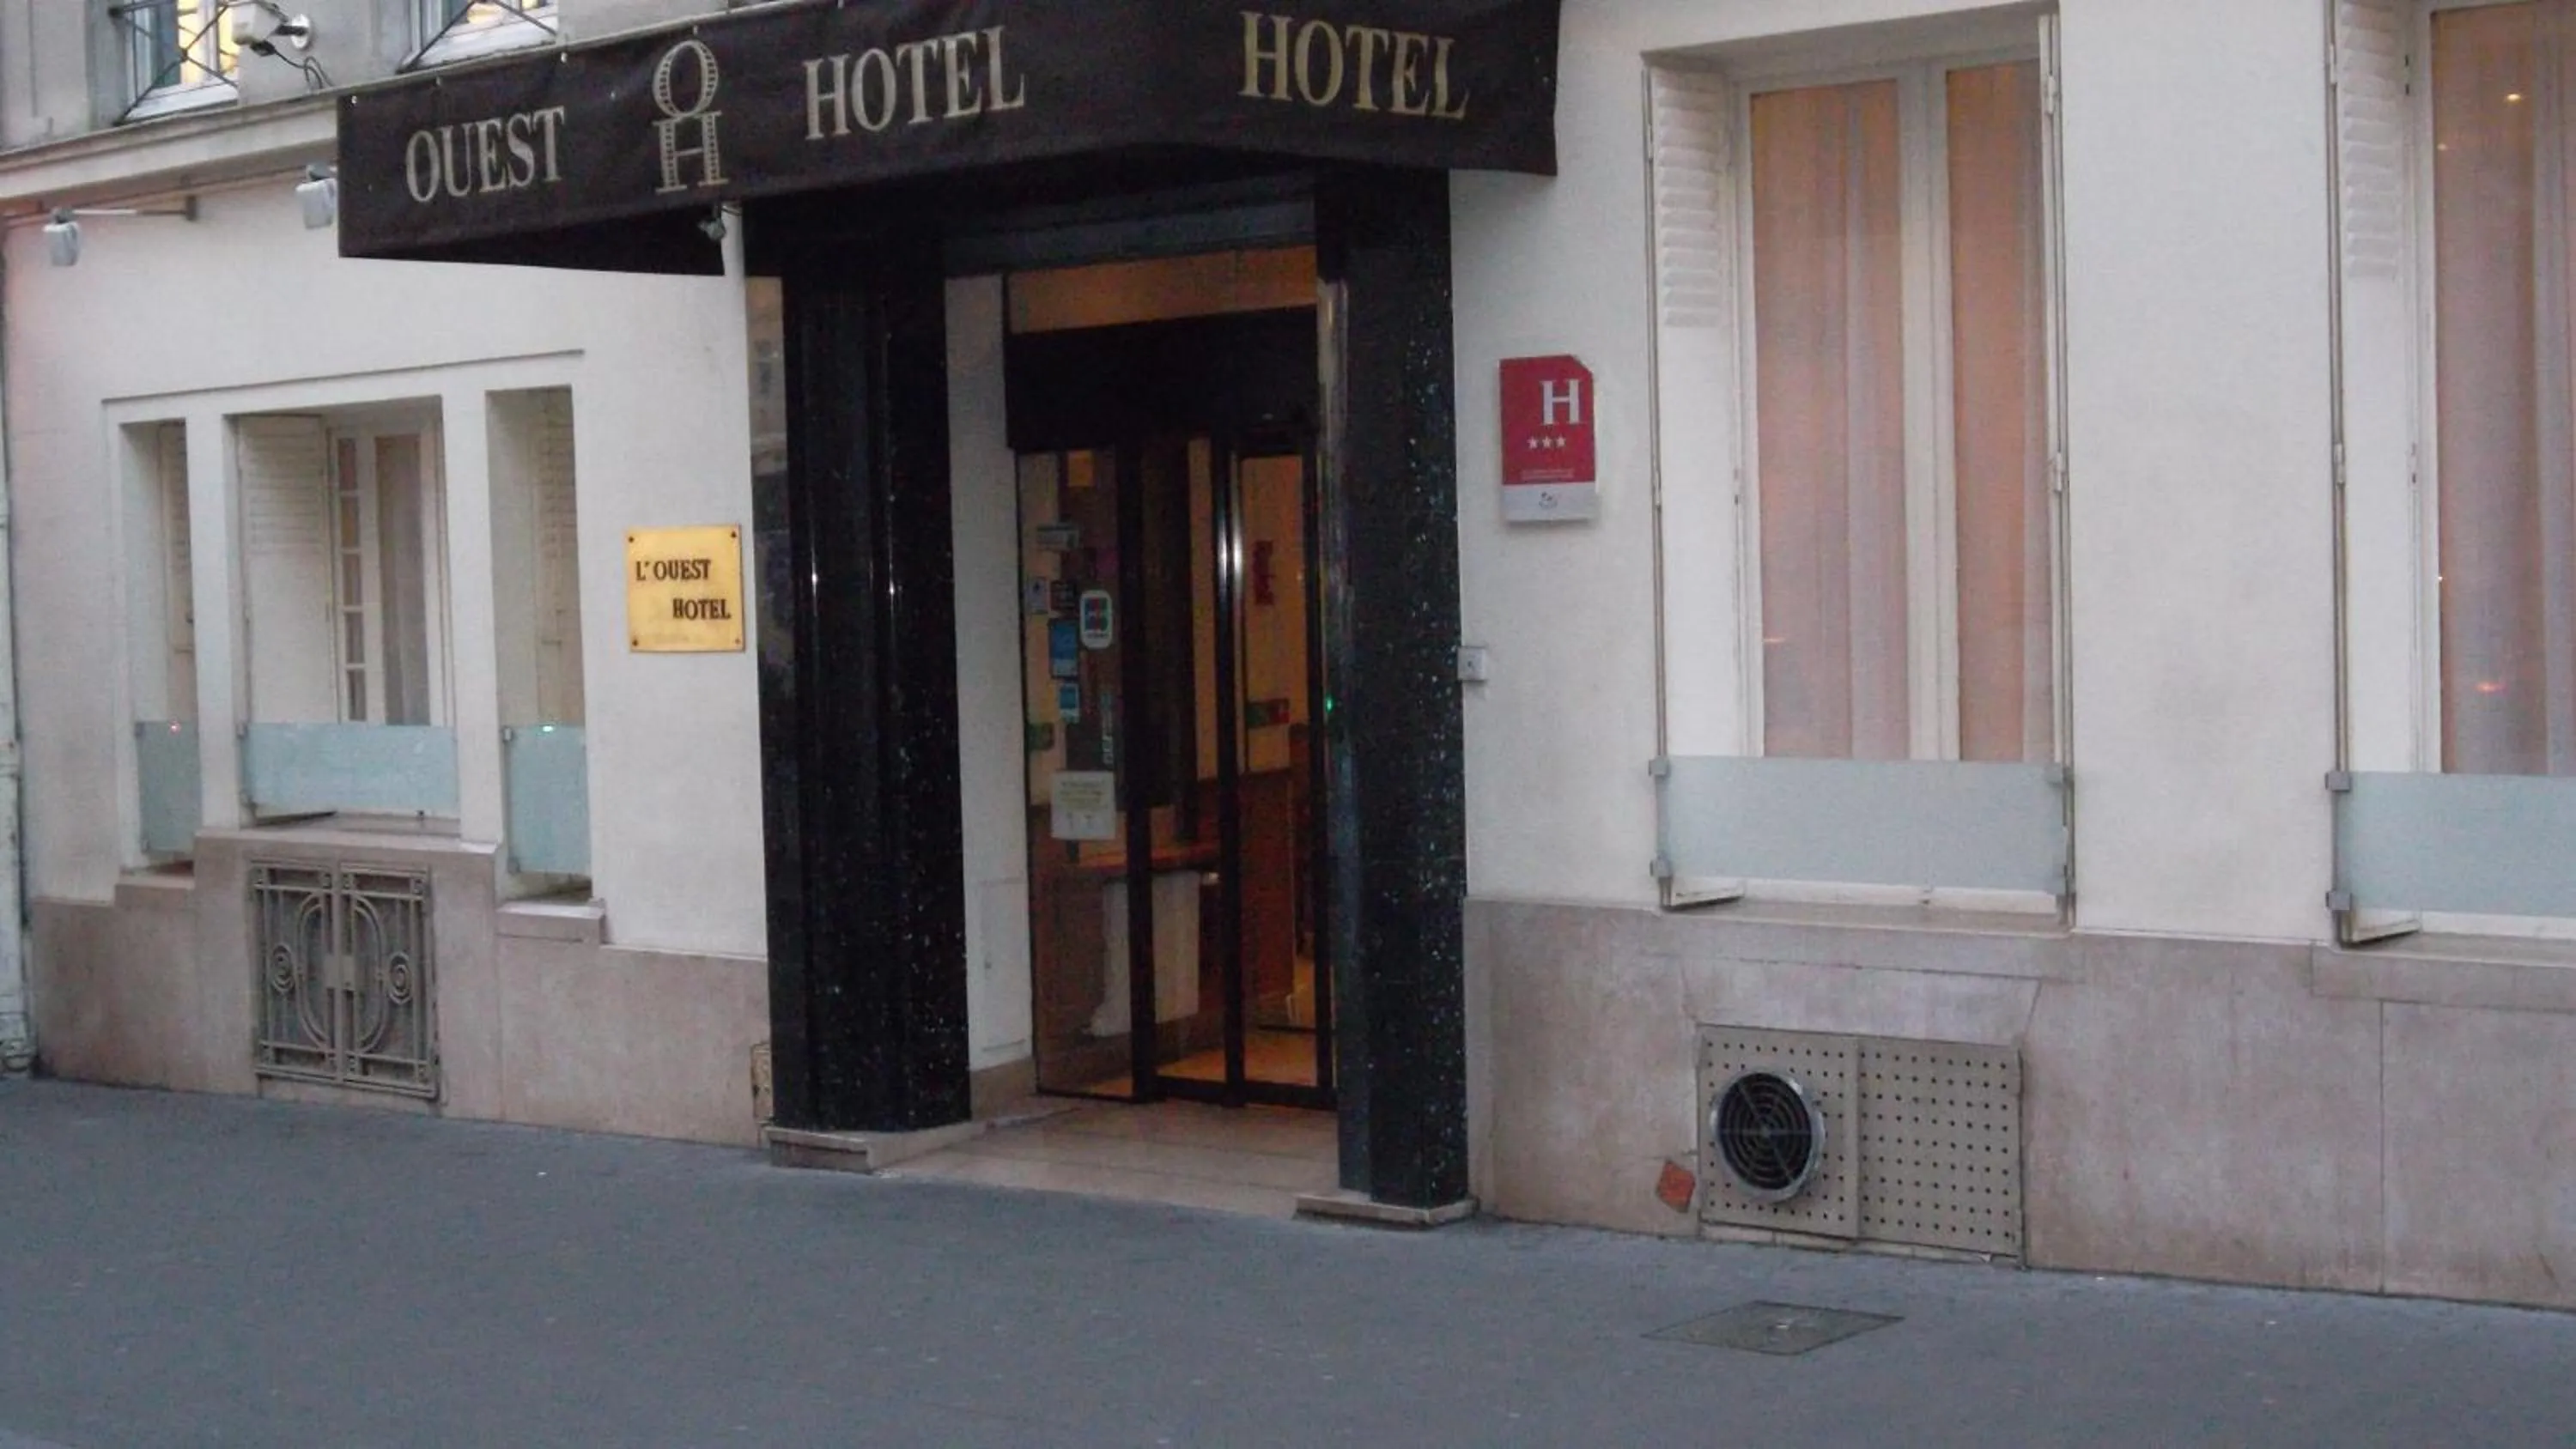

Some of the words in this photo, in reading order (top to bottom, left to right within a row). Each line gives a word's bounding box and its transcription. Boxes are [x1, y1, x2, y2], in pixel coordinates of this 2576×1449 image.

[1237, 10, 1469, 120] HOTEL
[405, 106, 566, 203] OUEST
[803, 26, 1025, 141] HOTEL
[1540, 379, 1583, 425] H
[635, 559, 711, 581] L'OUEST
[672, 598, 732, 620] HOTEL
